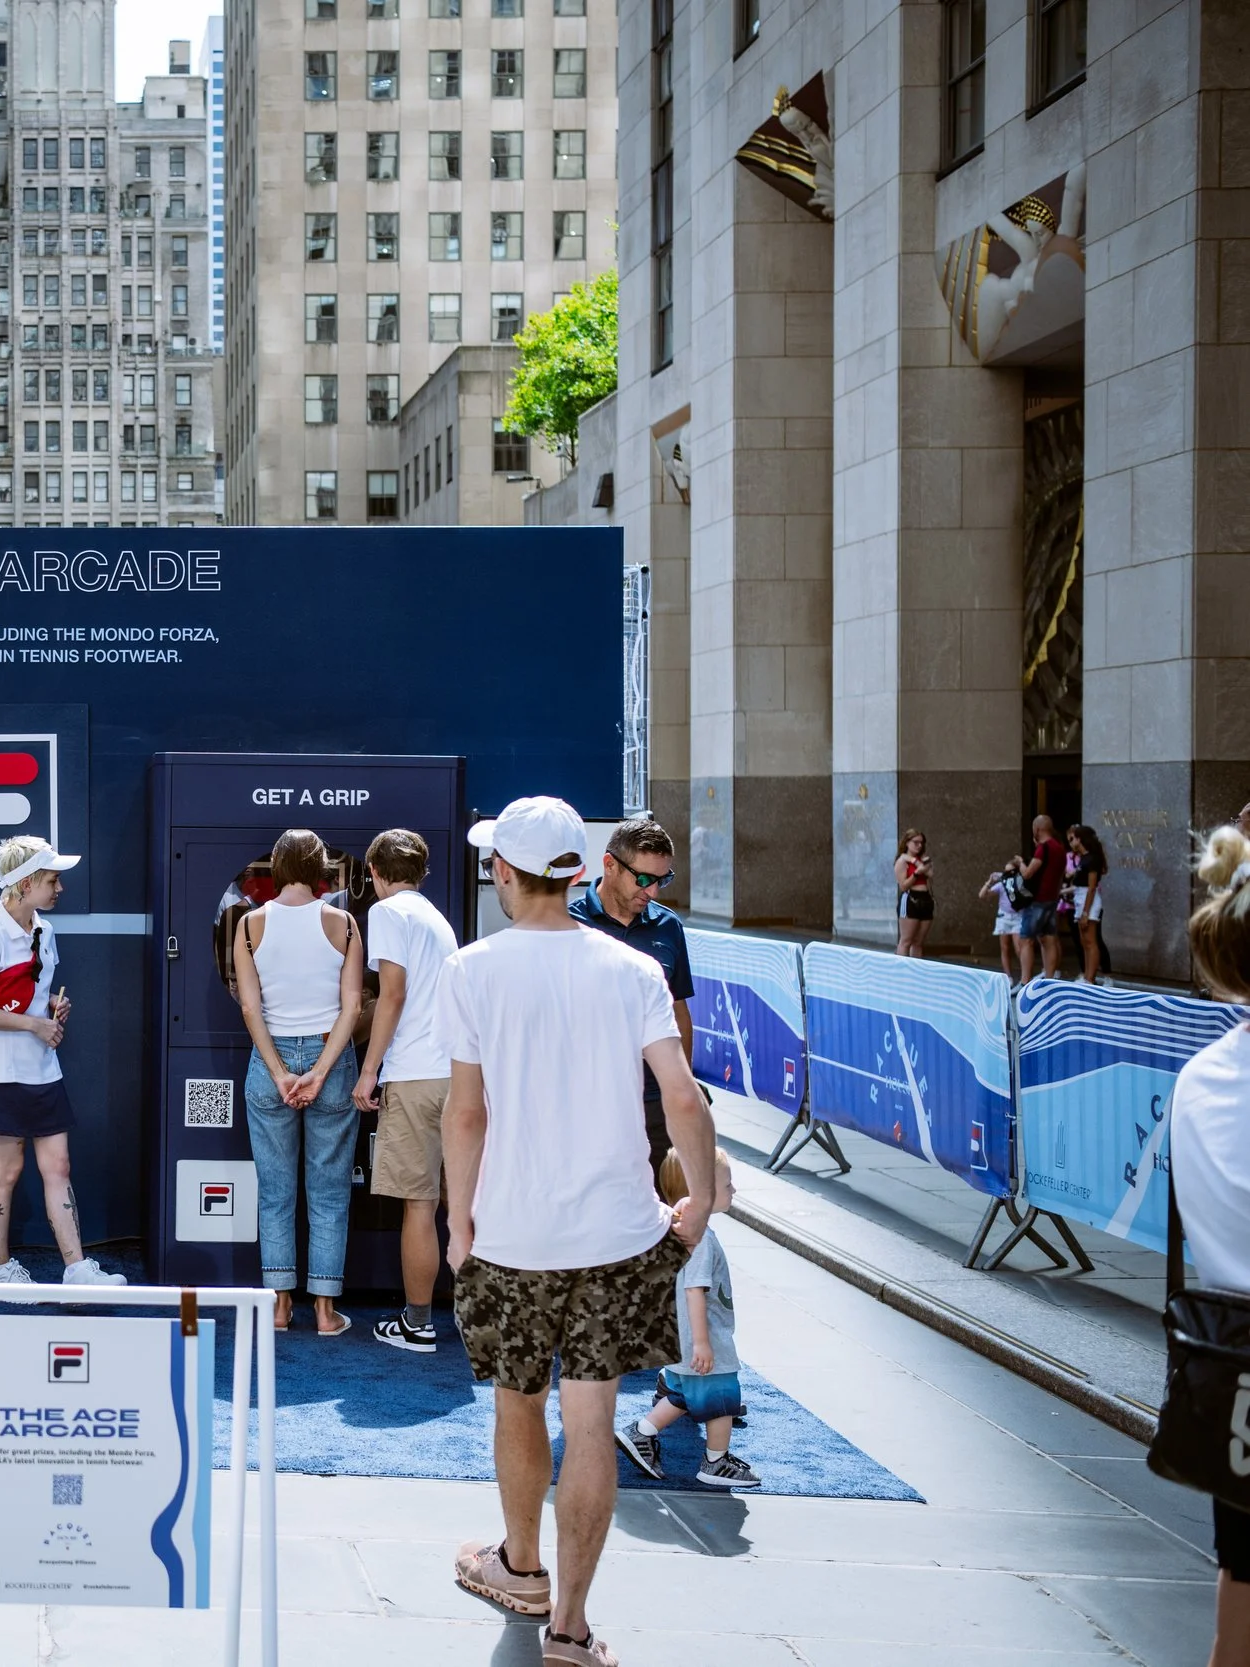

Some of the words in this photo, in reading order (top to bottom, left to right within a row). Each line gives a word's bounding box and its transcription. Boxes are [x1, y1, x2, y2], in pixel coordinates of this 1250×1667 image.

[53, 628, 86, 641] THE
[91, 627, 155, 642] MONDO
[160, 627, 220, 644] FORZA,
[0, 649, 15, 663] IN
[19, 649, 80, 663] TENNIS
[85, 649, 183, 663] FOOTWEAR.
[252, 788, 294, 805] GET
[299, 788, 314, 805] A
[319, 789, 370, 806] GRIP
[2, 999, 21, 1013] ILA
[1027, 1171, 1069, 1193] OCKEFELLER
[72, 1408, 140, 1422] ACE
[0, 1424, 139, 1438] ARCADE
[58, 1449, 92, 1458] including
